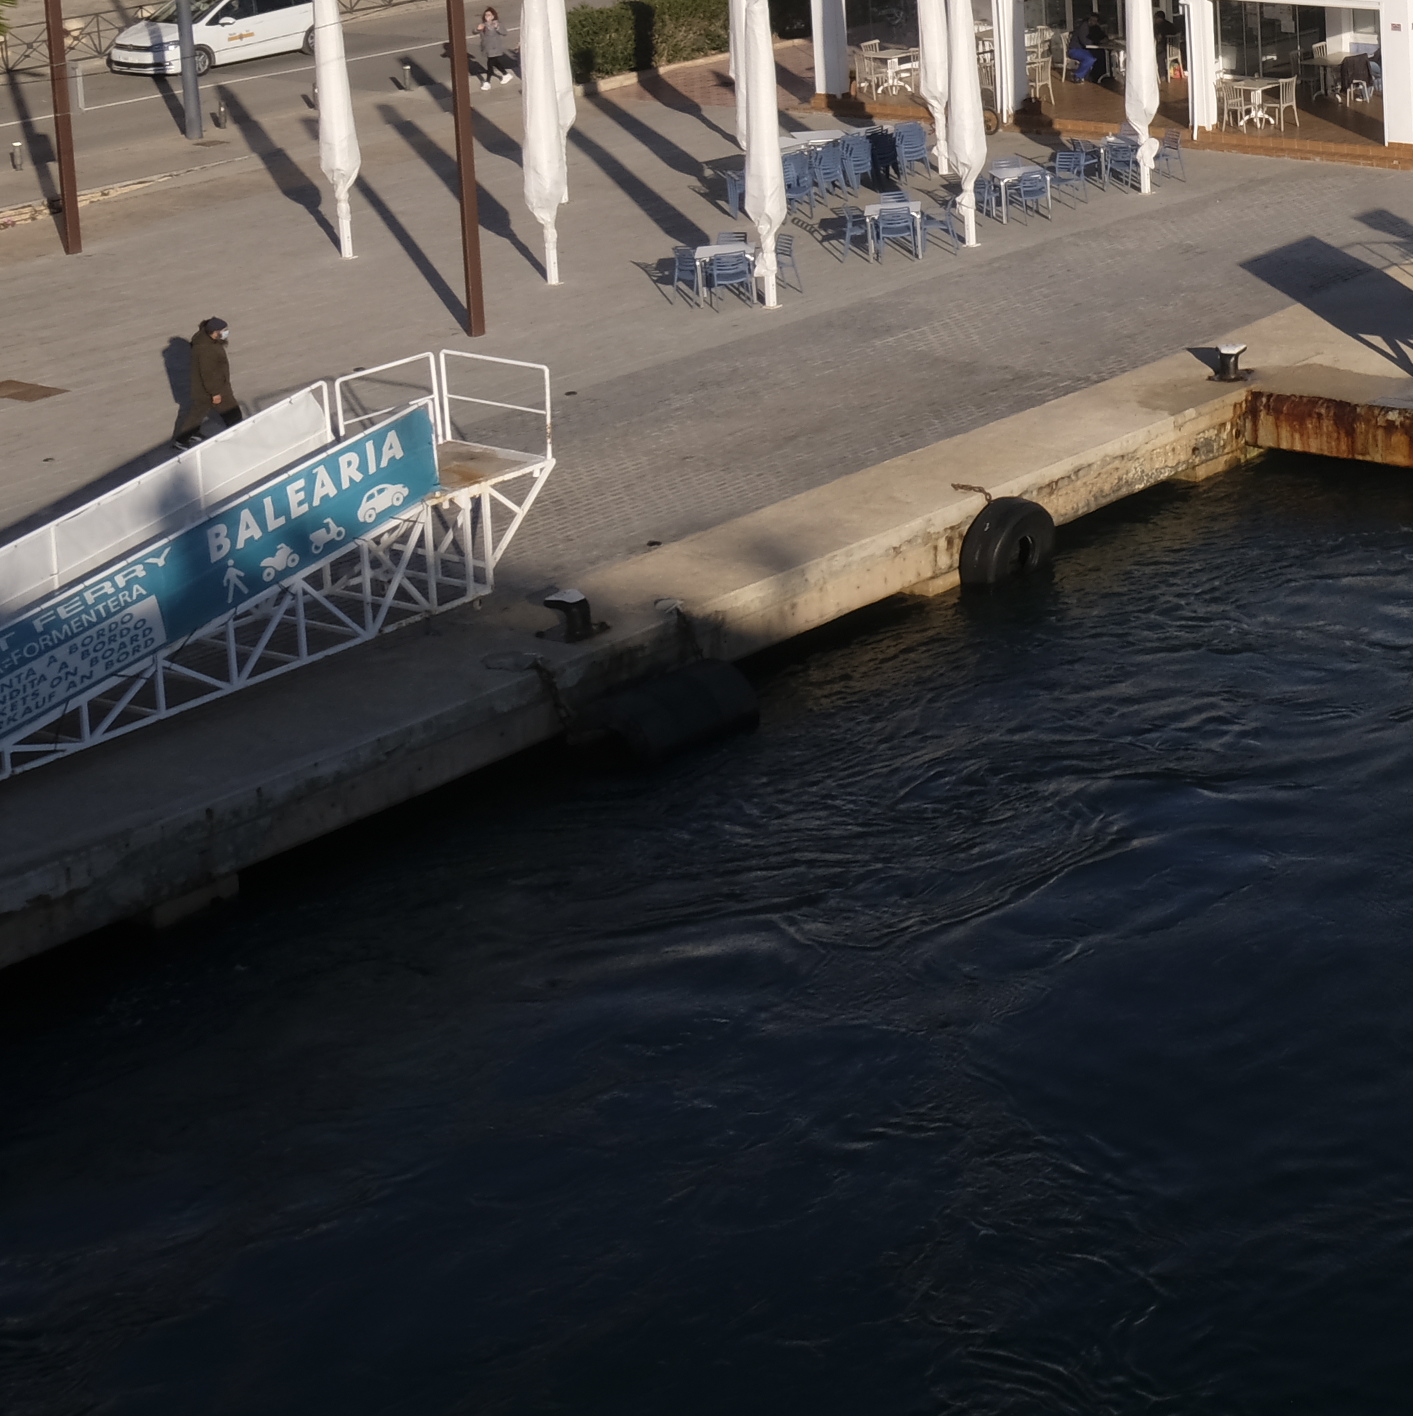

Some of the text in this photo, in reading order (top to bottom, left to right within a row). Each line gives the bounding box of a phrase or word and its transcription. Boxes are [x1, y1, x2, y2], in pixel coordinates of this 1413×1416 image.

[32, 547, 172, 633] FERRY
[47, 654, 58, 668] A
[69, 612, 134, 655] BORDO
[50, 668, 78, 688] ON
[90, 627, 153, 668] BOARD
[58, 661, 69, 674] A
[80, 619, 147, 661] BORDO
[66, 671, 93, 692] AN
[104, 637, 155, 671] BORD
